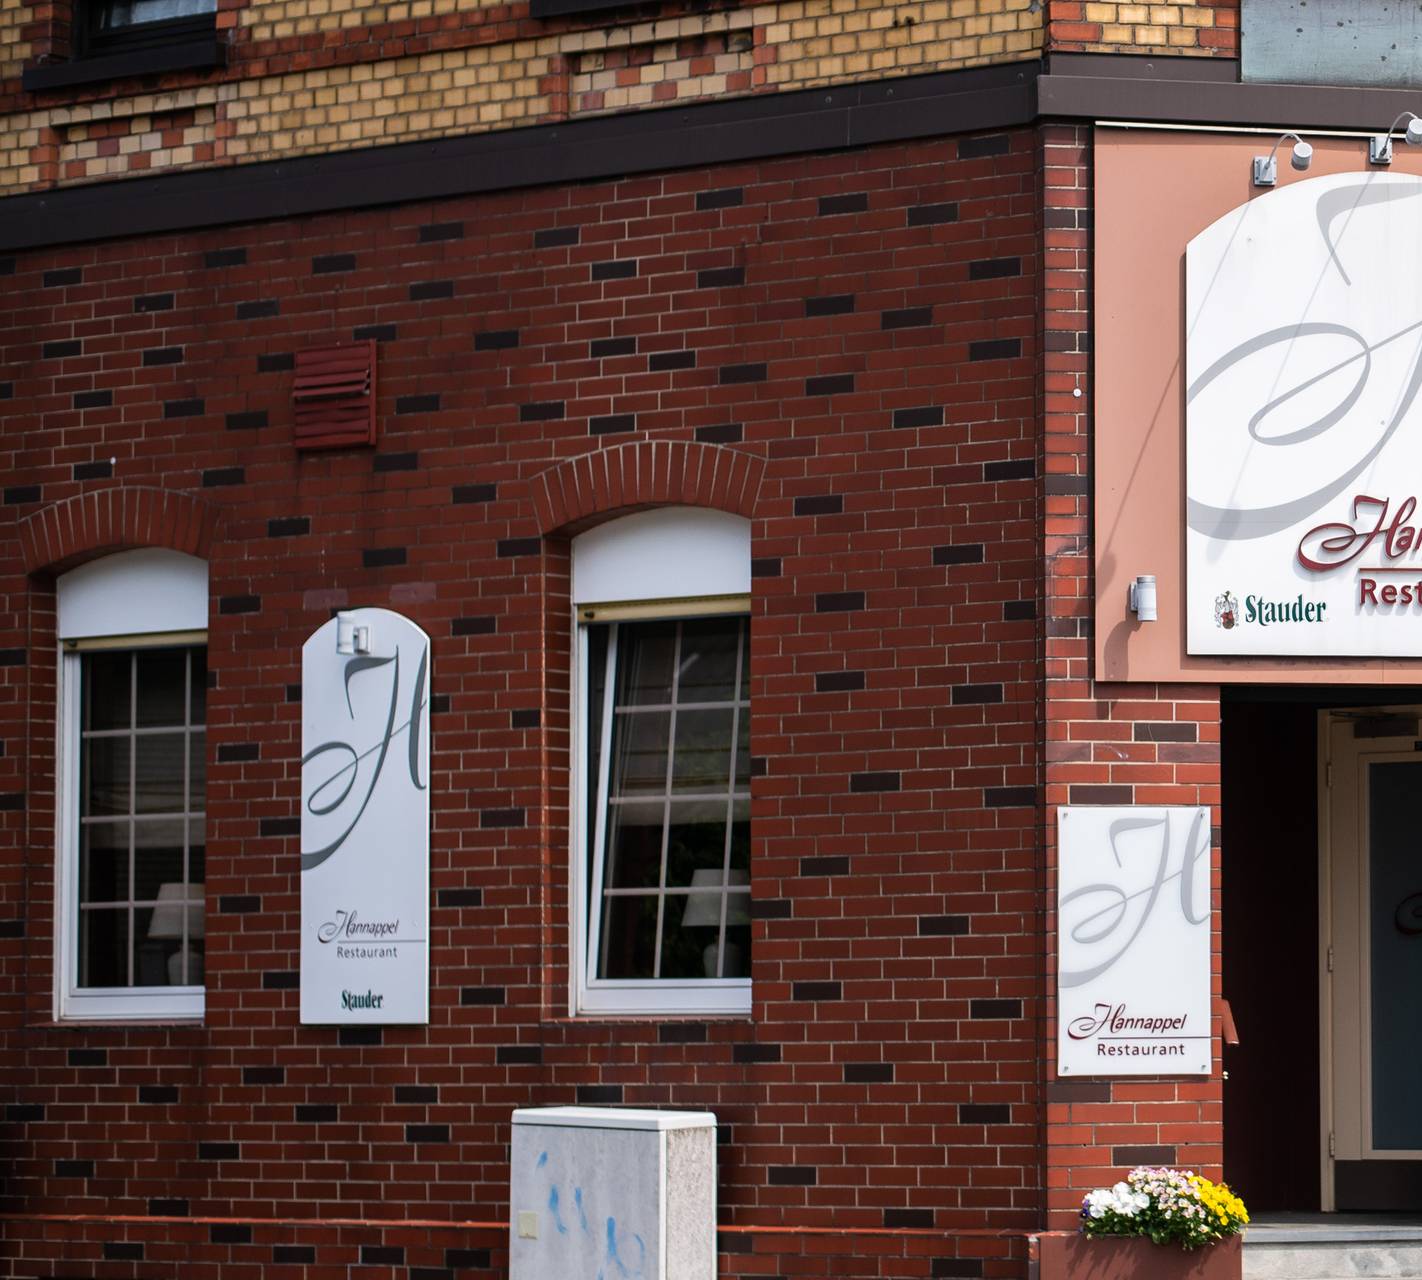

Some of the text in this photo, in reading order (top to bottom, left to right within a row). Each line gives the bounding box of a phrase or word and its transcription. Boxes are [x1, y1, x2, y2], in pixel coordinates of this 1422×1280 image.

[1245, 594, 1328, 626] Stauder
[317, 909, 399, 944] Hannappel
[336, 946, 398, 958] Restaurant
[341, 989, 384, 1011] Stauder
[1067, 1002, 1188, 1040] Hannappel
[1097, 1043, 1185, 1056] Restaurant
